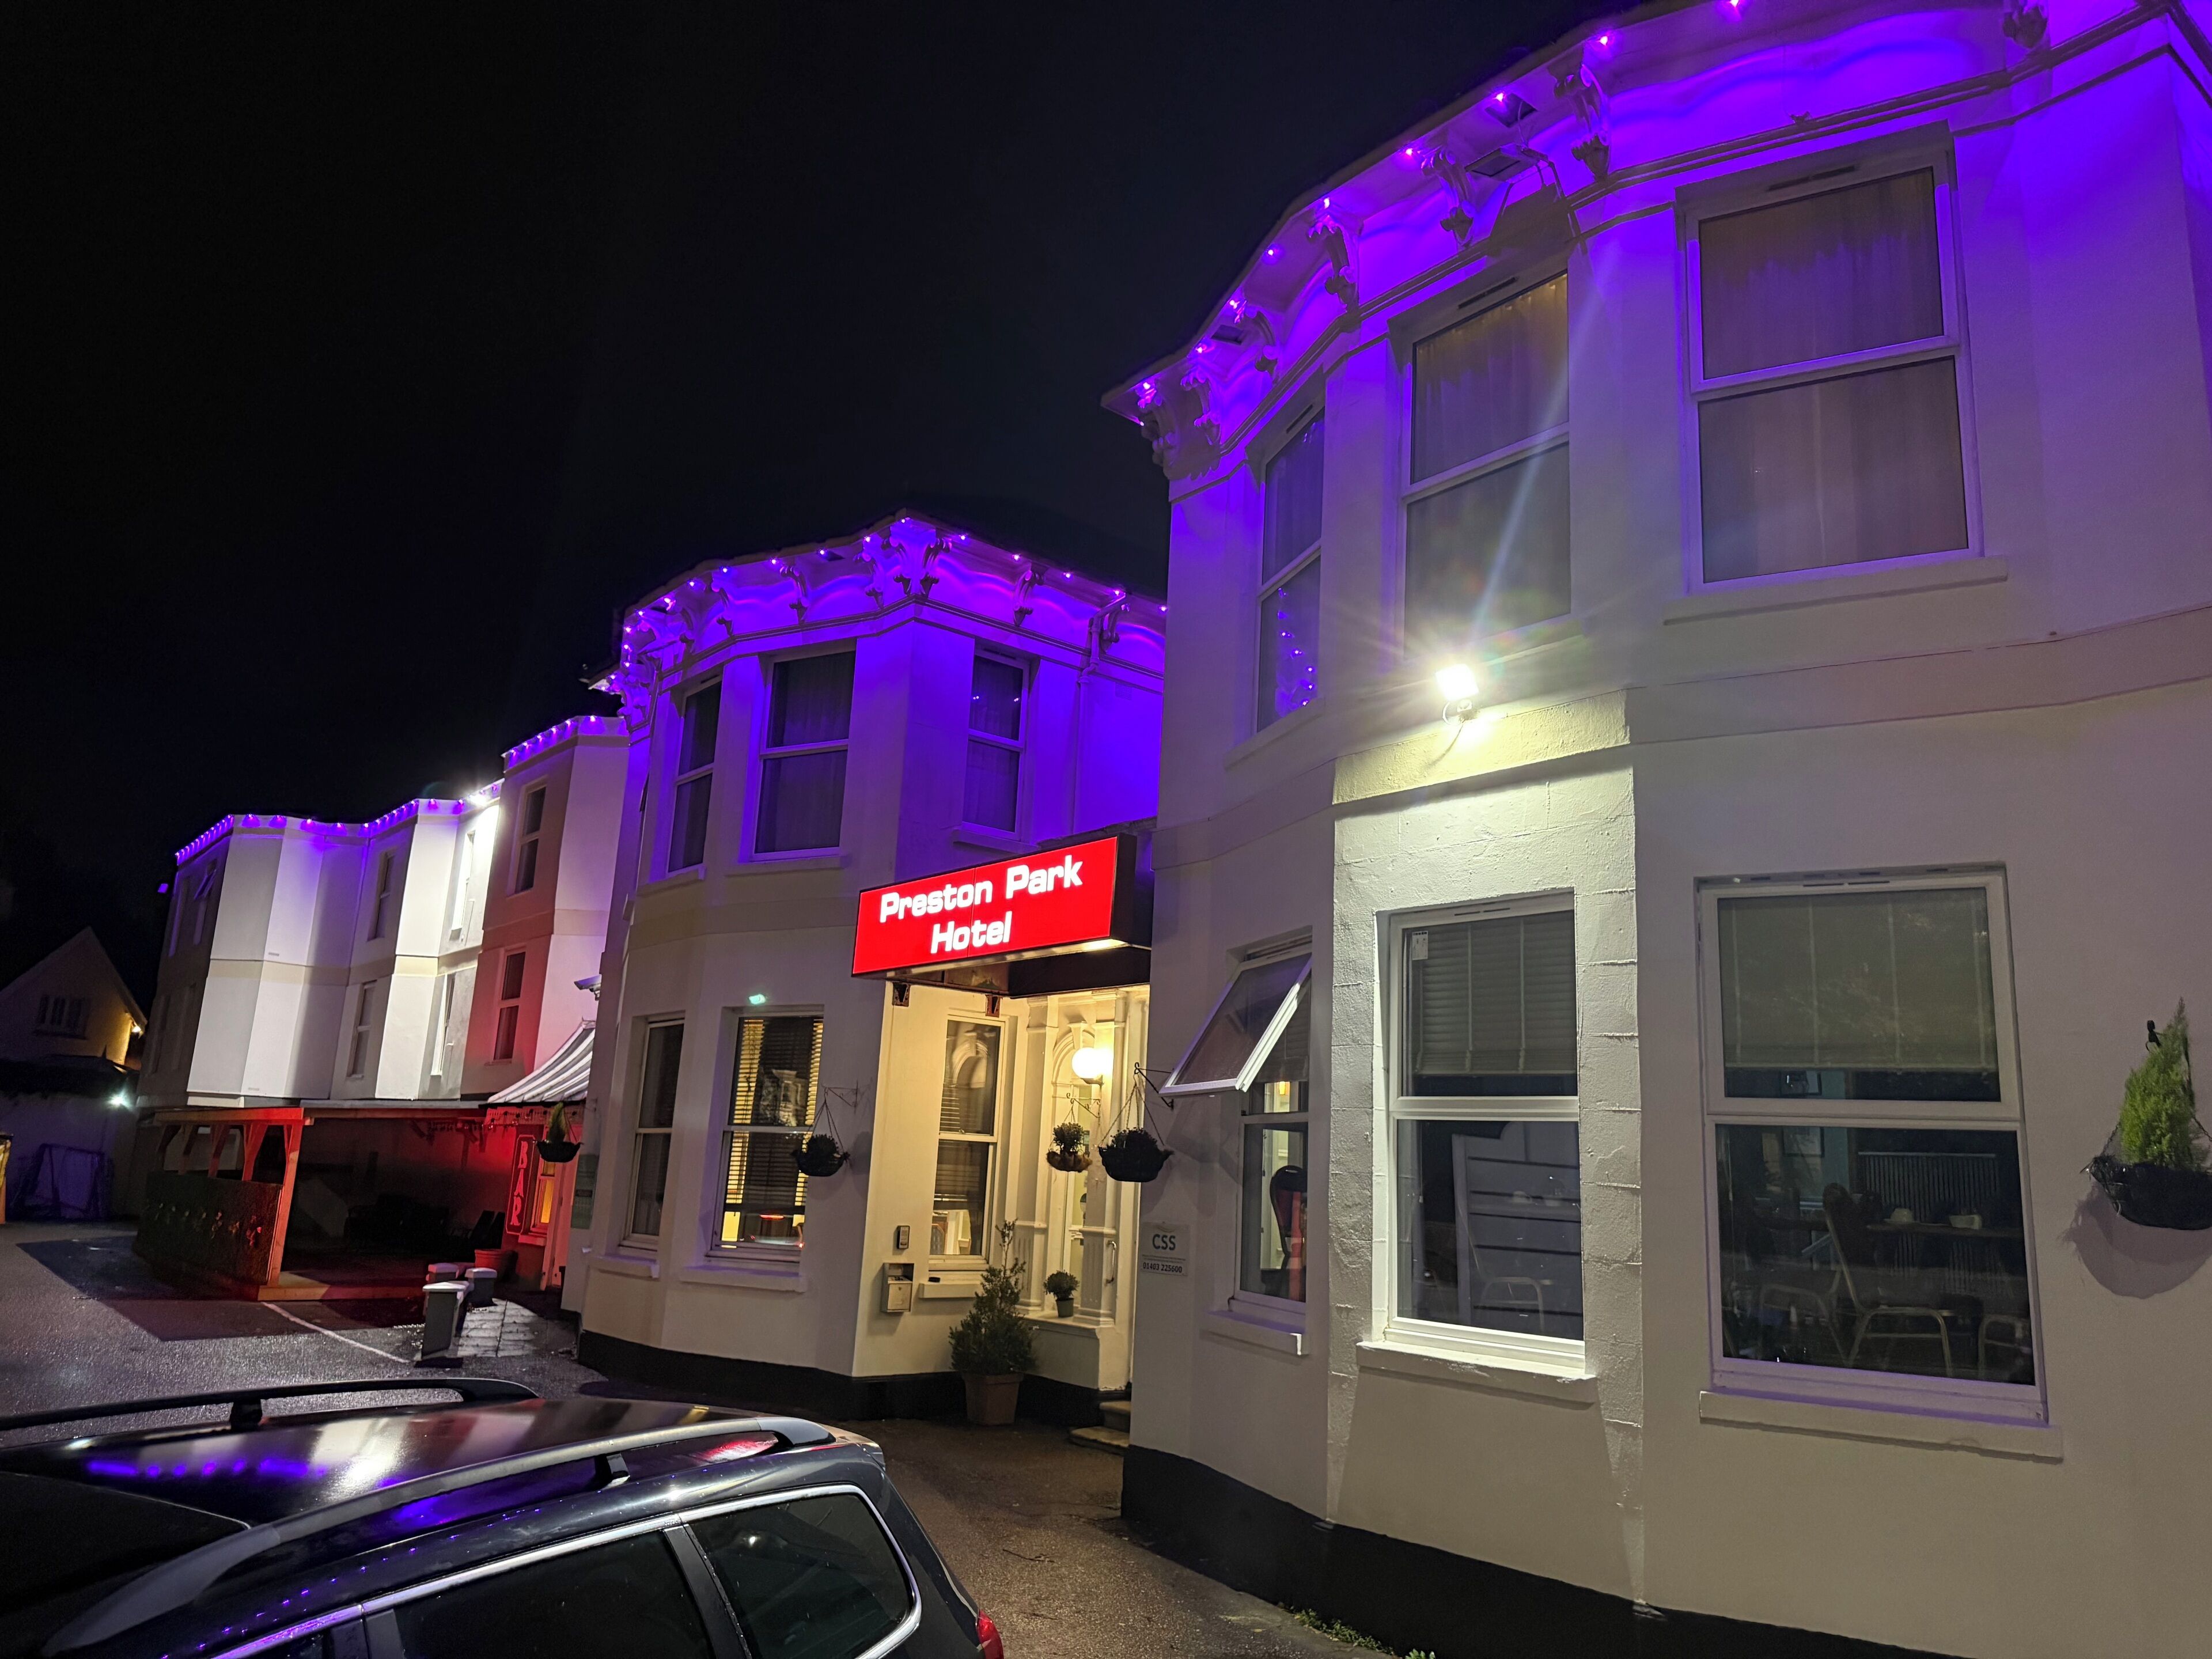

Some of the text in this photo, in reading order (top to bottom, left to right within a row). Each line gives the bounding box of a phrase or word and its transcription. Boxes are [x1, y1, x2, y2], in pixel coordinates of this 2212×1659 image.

[880, 854, 1083, 923] Preston Park
[930, 911, 1013, 954] Hotel
[510, 1141, 528, 1226] BAR
[1152, 1234, 1176, 1250] CSS
[1143, 1262, 1182, 1273] 01403 225600
